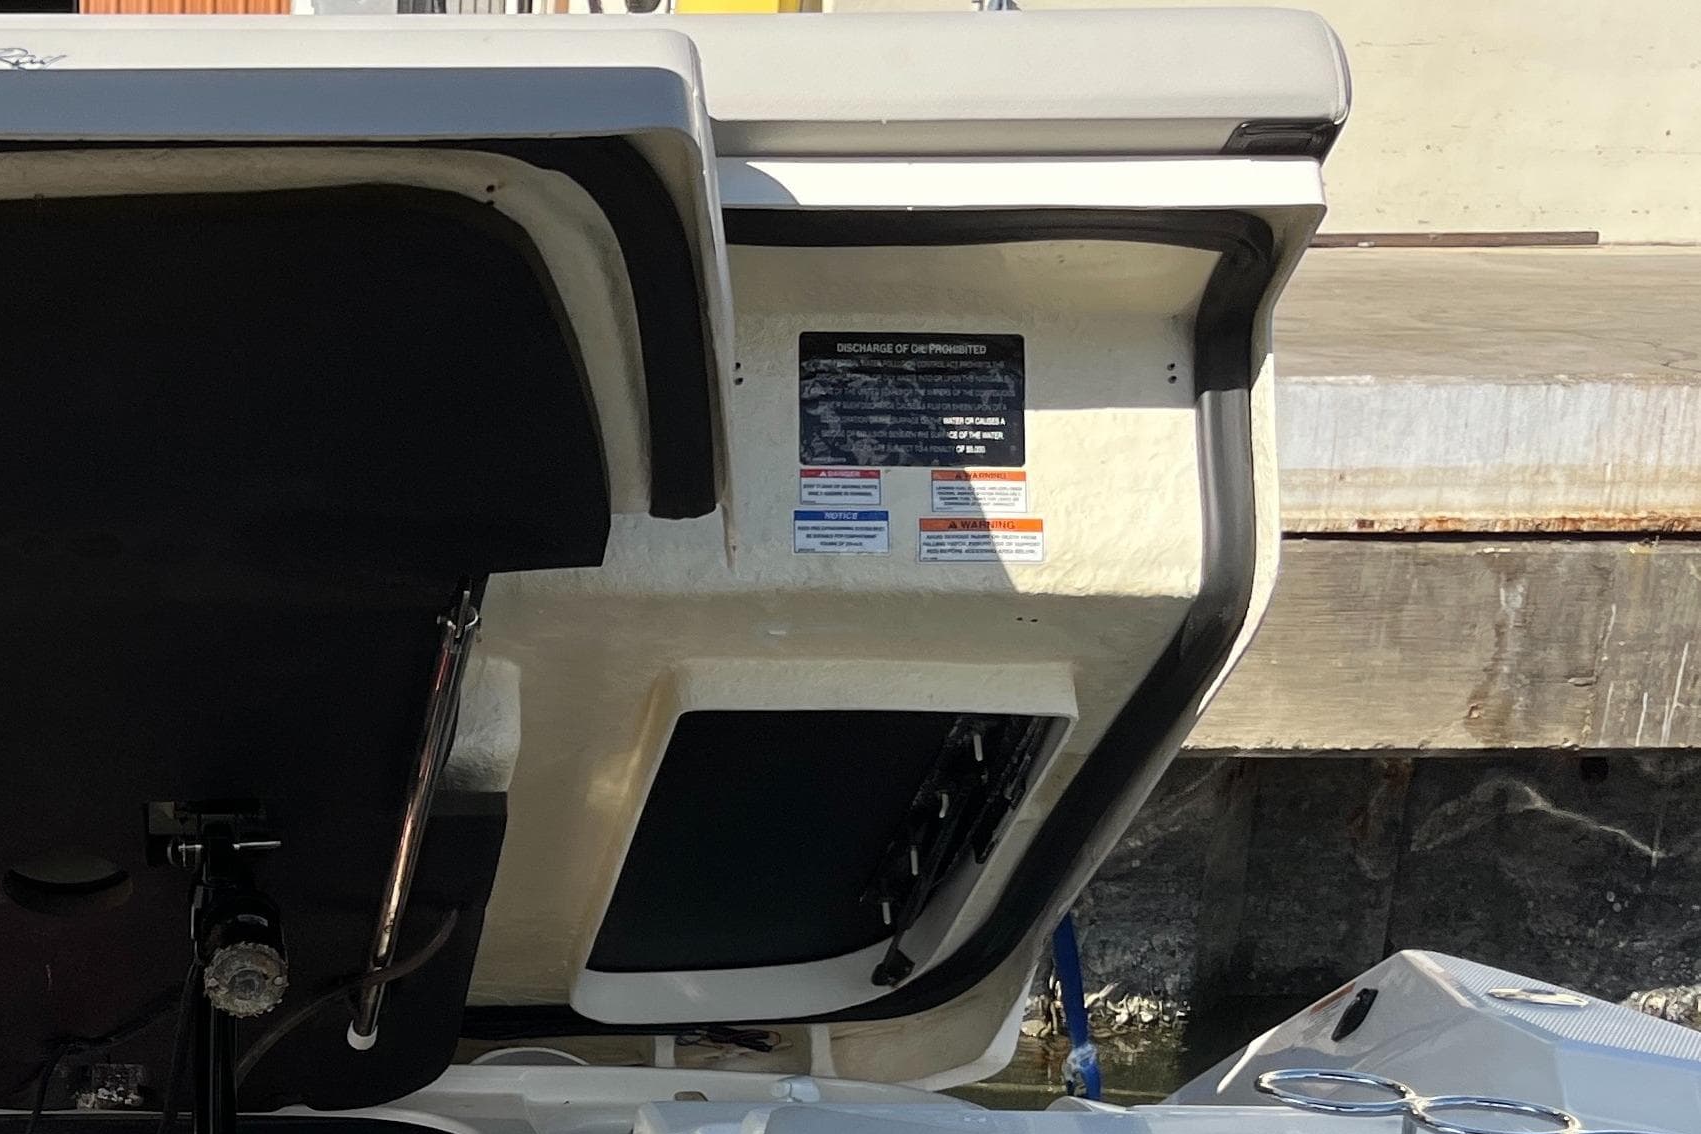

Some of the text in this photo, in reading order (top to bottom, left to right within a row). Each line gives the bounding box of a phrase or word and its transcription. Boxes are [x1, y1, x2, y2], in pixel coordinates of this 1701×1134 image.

[836, 342, 893, 354] DISCHARGE
[895, 343, 909, 354] OF
[929, 343, 987, 355] PROHIBITED
[823, 512, 858, 520] NOTICE
[960, 521, 1015, 530] WARNING
